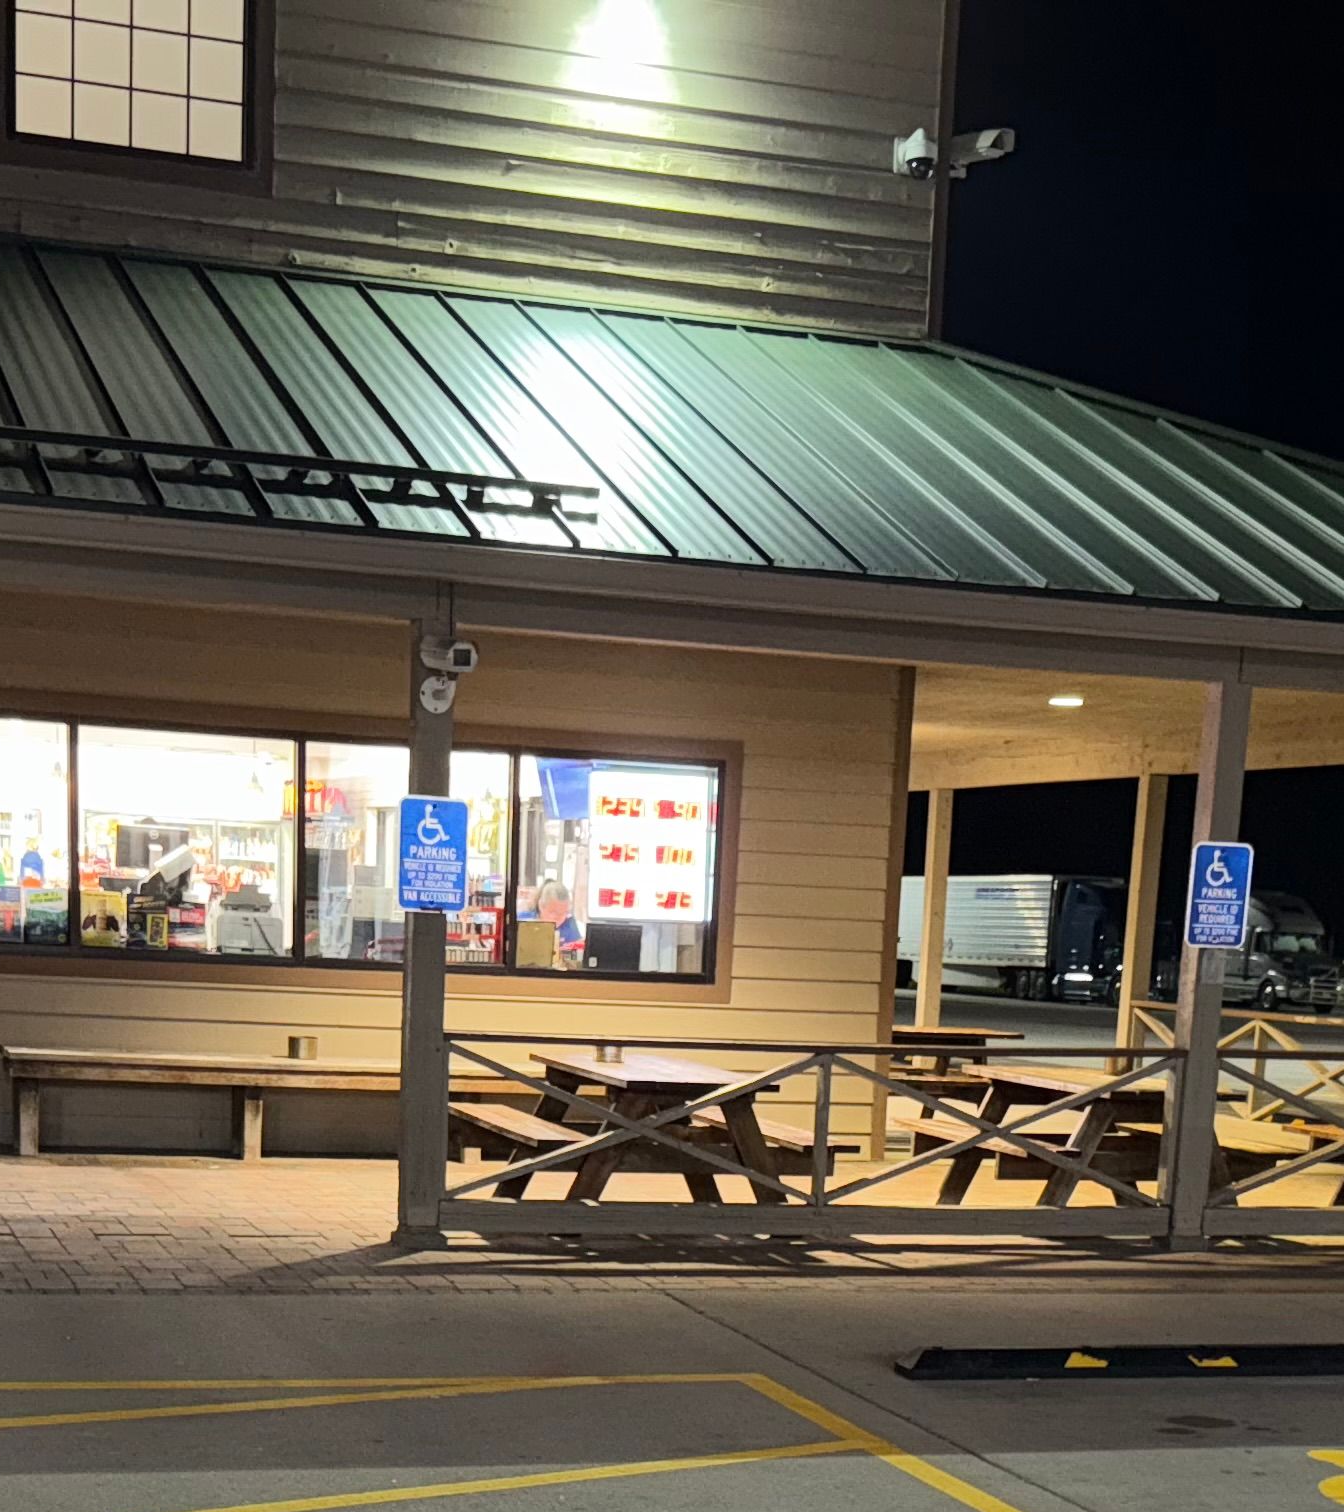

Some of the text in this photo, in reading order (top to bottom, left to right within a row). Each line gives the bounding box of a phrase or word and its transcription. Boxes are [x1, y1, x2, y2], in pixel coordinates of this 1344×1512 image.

[409, 845, 457, 861] PARKING
[403, 890, 461, 904] VAN ACCESSIBLE
[1201, 887, 1237, 899] PARKING
[1198, 903, 1228, 914] VEHICLE
[1198, 913, 1236, 924] REQUIRED
